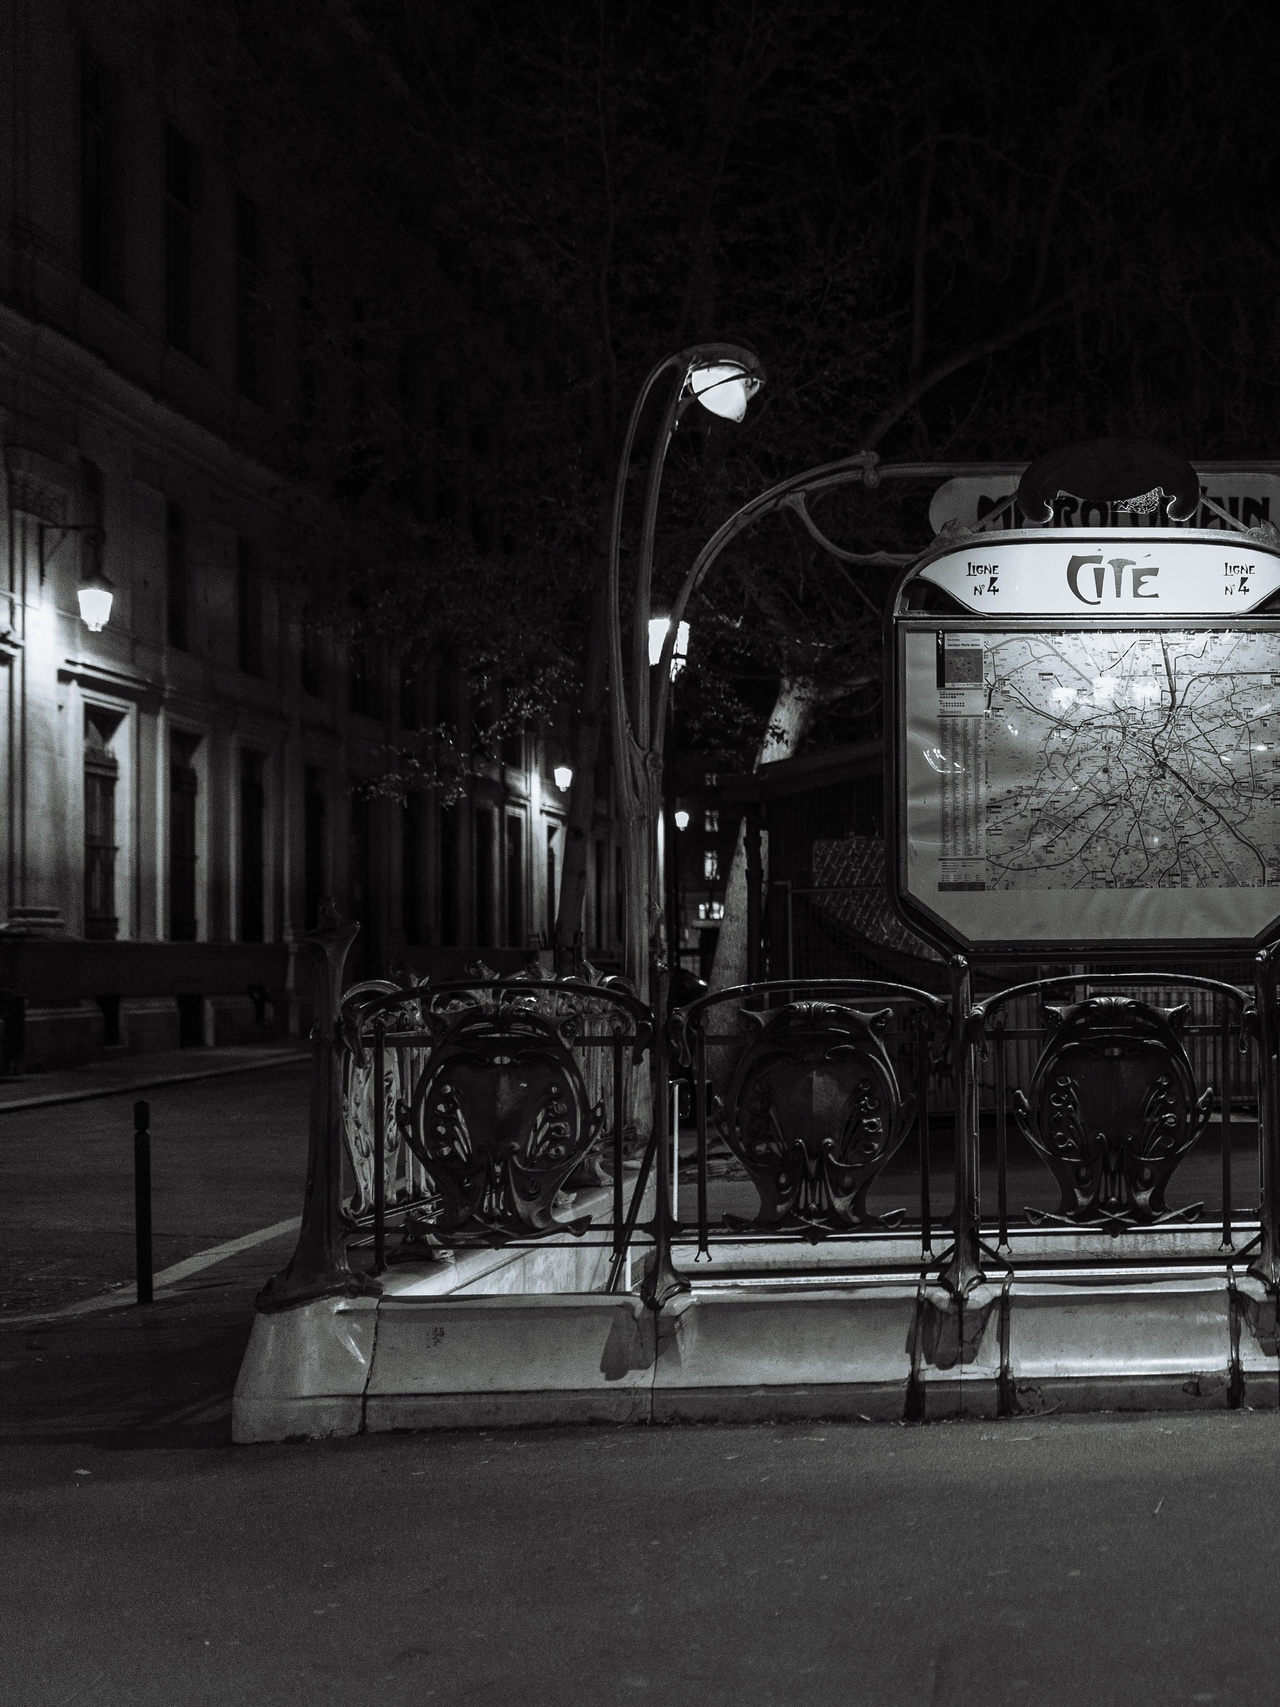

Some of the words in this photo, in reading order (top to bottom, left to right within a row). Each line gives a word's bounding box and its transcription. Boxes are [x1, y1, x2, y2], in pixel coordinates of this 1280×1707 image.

[966, 562, 999, 576] LIGNE
[1066, 548, 1159, 605] CITÉ
[1223, 562, 1256, 576] LIGNE
[987, 576, 999, 596] 4
[1238, 576, 1250, 596] 4
